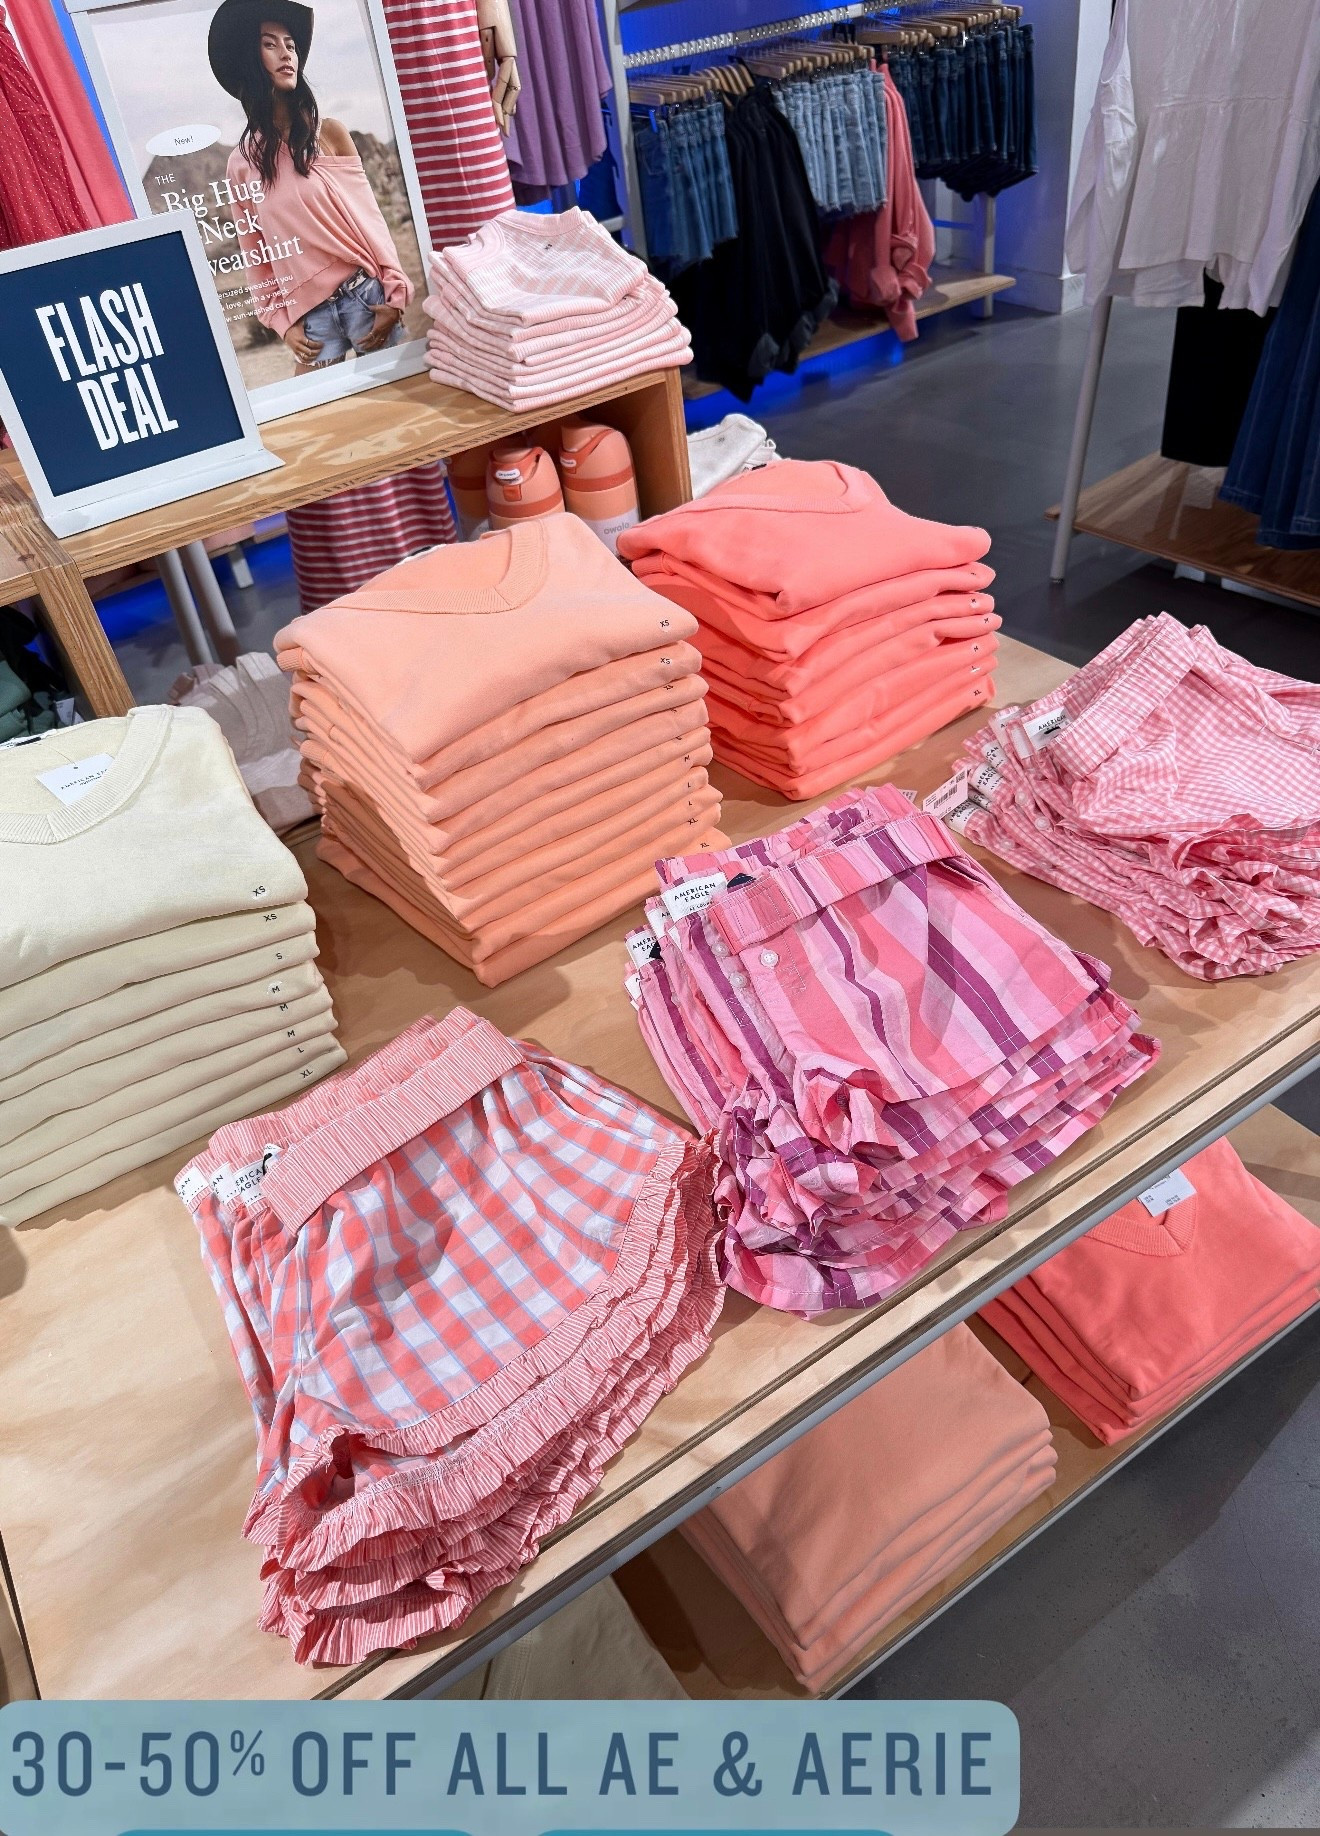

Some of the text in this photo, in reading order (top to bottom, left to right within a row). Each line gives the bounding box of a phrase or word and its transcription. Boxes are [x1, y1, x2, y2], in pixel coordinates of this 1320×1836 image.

[174, 136, 194, 146] New!
[155, 173, 176, 186] THE
[161, 178, 265, 218] Big Hug
[198, 208, 263, 245] Neck
[208, 235, 304, 277] weatshirt
[218, 275, 293, 300] ersized sweatshirt you
[226, 301, 244, 310] love,
[244, 296, 260, 305] with
[266, 287, 289, 299] v-neck
[233, 304, 274, 321] sun-washed
[35, 283, 164, 382] FLASH
[76, 363, 179, 451] DEAL
[660, 620, 670, 628] XS
[660, 657, 671, 665] XS
[253, 885, 266, 896] XS
[674, 882, 716, 901] AMERICAN
[684, 890, 710, 902] EAGLE
[263, 913, 277, 922] XS
[276, 952, 283, 960] S
[272, 985, 281, 994] M
[280, 1003, 288, 1011] M
[287, 1029, 295, 1037] M
[300, 1069, 313, 1079] XL
[235, 1168, 262, 1187] ERICA
